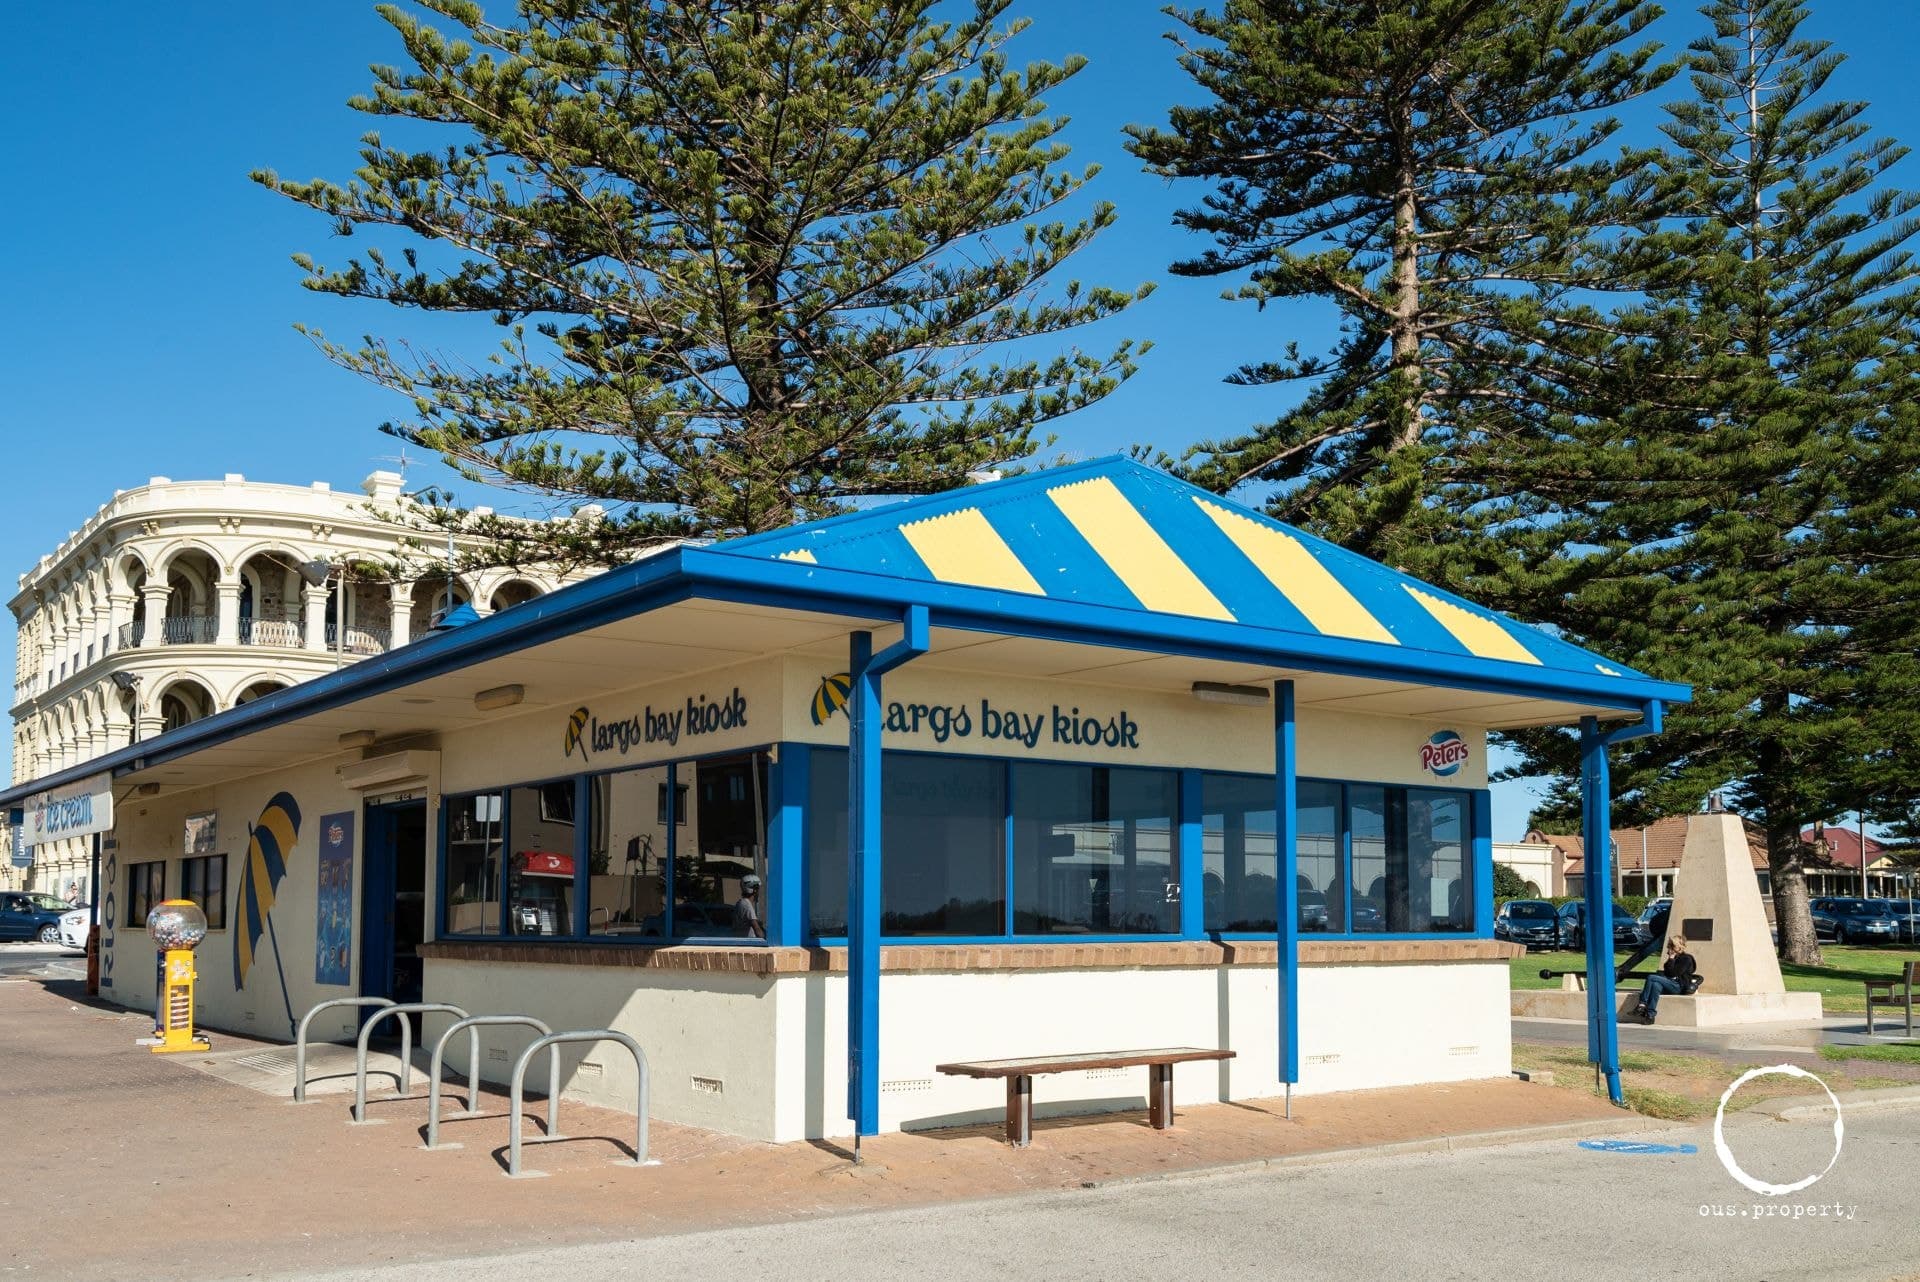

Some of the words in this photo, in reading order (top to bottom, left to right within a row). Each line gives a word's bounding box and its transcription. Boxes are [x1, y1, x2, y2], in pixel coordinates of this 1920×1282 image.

[591, 715, 641, 754] largs
[645, 705, 683, 746] bay
[686, 687, 748, 736] kiosk
[880, 701, 972, 743] args
[981, 699, 1044, 748] bay
[1052, 704, 1139, 749] kiosk
[1419, 740, 1469, 770] Peters
